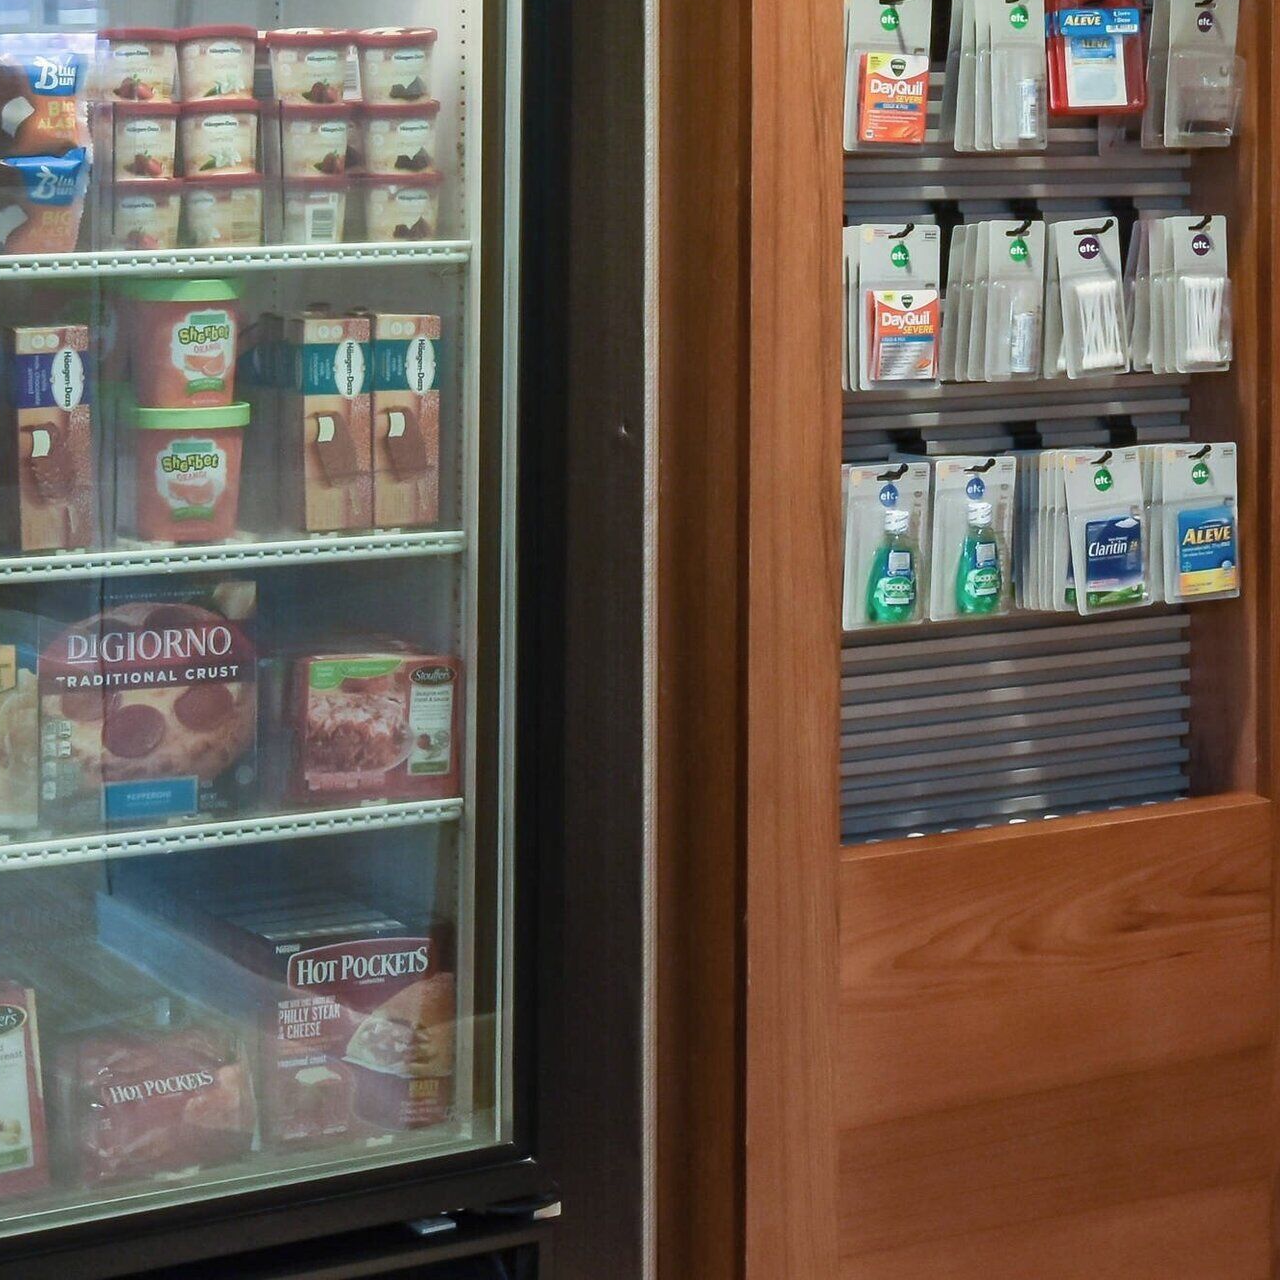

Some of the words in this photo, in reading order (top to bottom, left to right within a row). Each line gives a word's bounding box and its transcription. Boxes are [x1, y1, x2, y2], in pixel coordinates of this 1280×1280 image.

[1063, 15, 1102, 26] ALEVE
[870, 79, 924, 98] DayQuil
[1079, 243, 1100, 253] etc.
[1192, 240, 1210, 250] etc.
[881, 311, 930, 329] DayQuil
[902, 325, 934, 334] SEVERE
[178, 324, 230, 346] Sherbet
[161, 453, 219, 473] Sherbet
[1182, 526, 1232, 546] ALEVE
[1088, 539, 1128, 557] Claritin
[66, 626, 232, 665] DIGIORNO
[56, 668, 178, 688] TRADITIONAL
[185, 665, 239, 681] CRUST
[297, 959, 338, 986] HOT
[341, 946, 430, 981] POCKETS
[278, 1006, 309, 1025] PHILLY
[312, 1003, 341, 1021] STEAK
[287, 1022, 321, 1040] CHEESE
[109, 1084, 145, 1104] HOT
[145, 1070, 214, 1097] POCKETS
